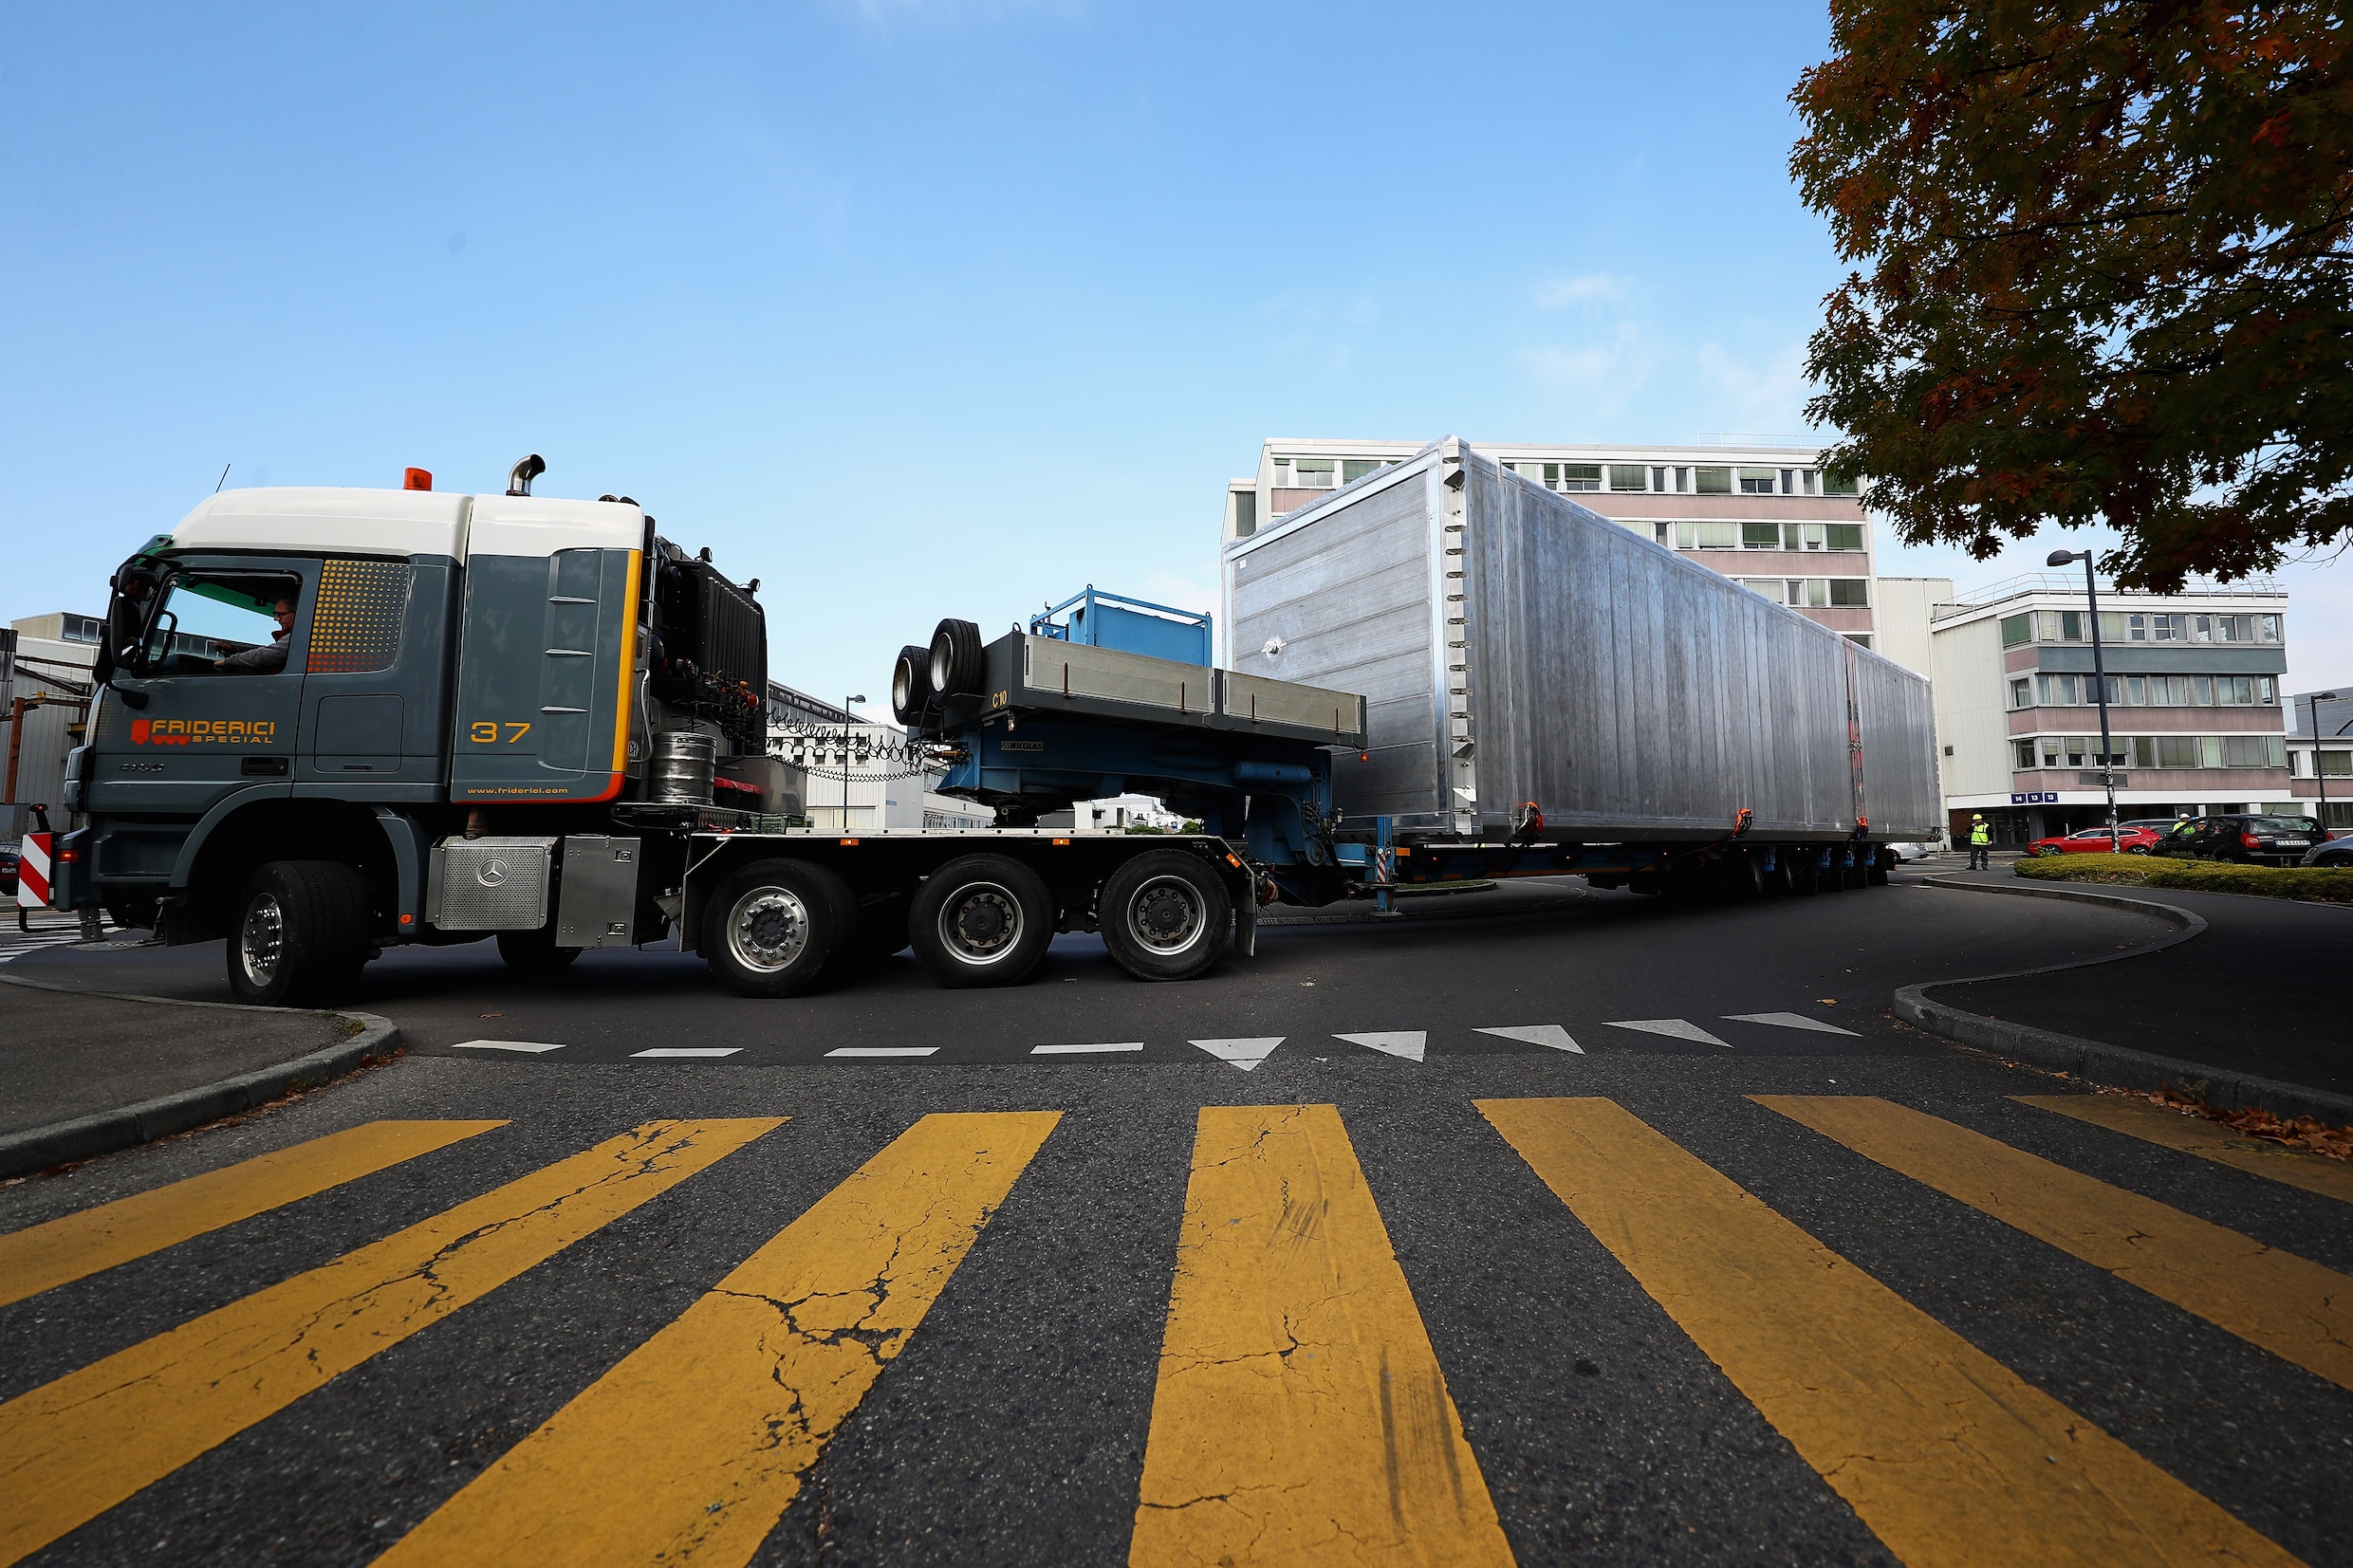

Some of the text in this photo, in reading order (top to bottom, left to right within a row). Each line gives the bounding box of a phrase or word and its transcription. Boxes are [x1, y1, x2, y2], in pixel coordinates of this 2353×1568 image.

[152, 719, 275, 735] FRIDERICI
[470, 721, 532, 744] 37
[192, 735, 273, 744] SPECIAL
